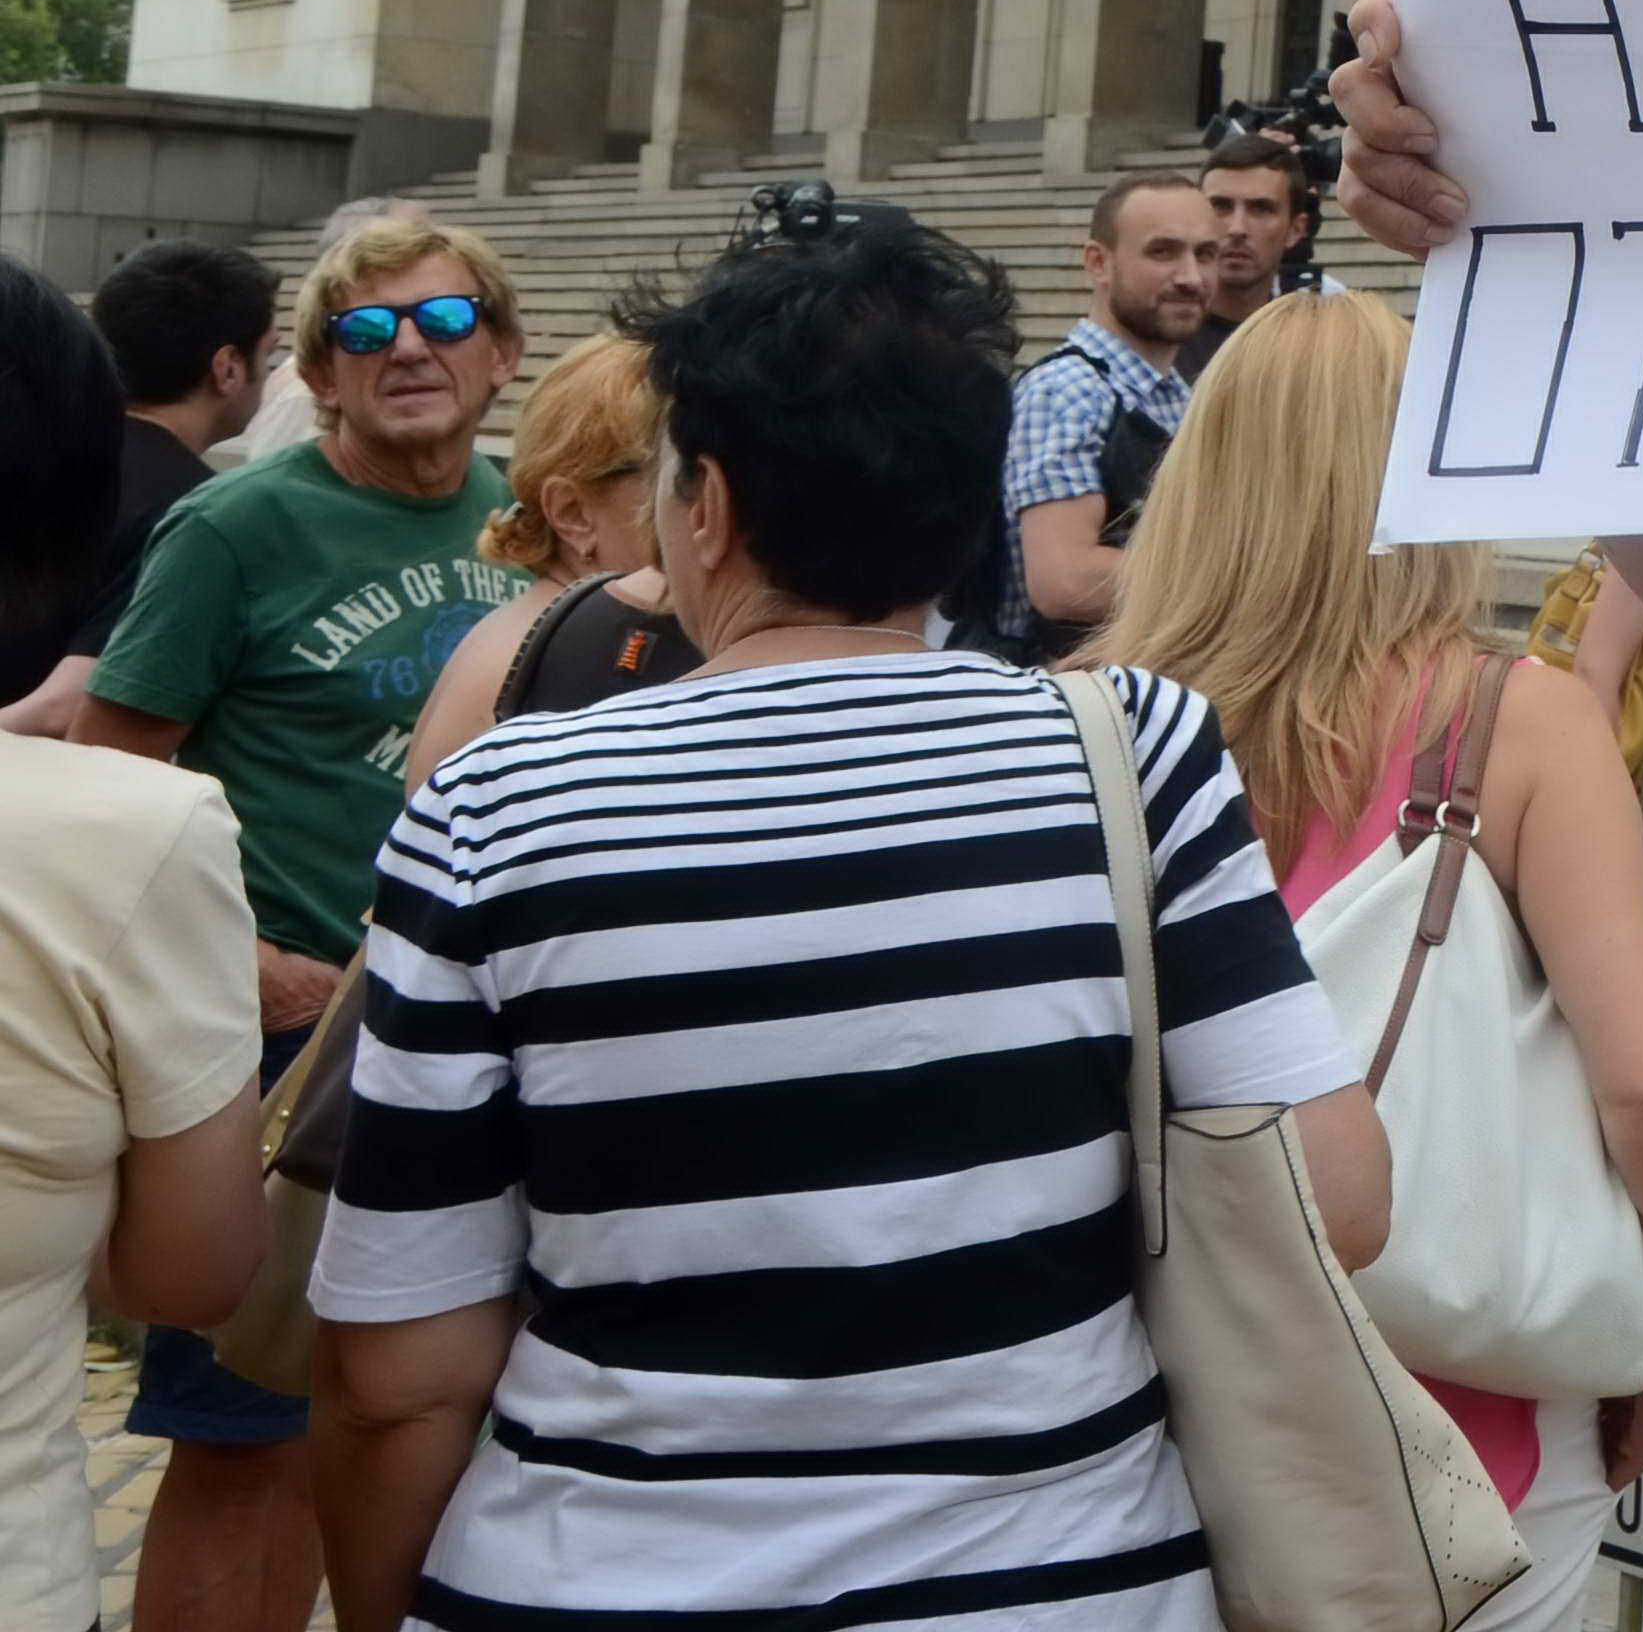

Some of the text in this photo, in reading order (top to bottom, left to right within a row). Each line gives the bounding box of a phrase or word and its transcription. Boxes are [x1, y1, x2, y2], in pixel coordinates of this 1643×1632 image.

[291, 582, 403, 672] LAND
[400, 563, 446, 608] OF
[452, 559, 510, 606] THE
[361, 655, 420, 701] 76
